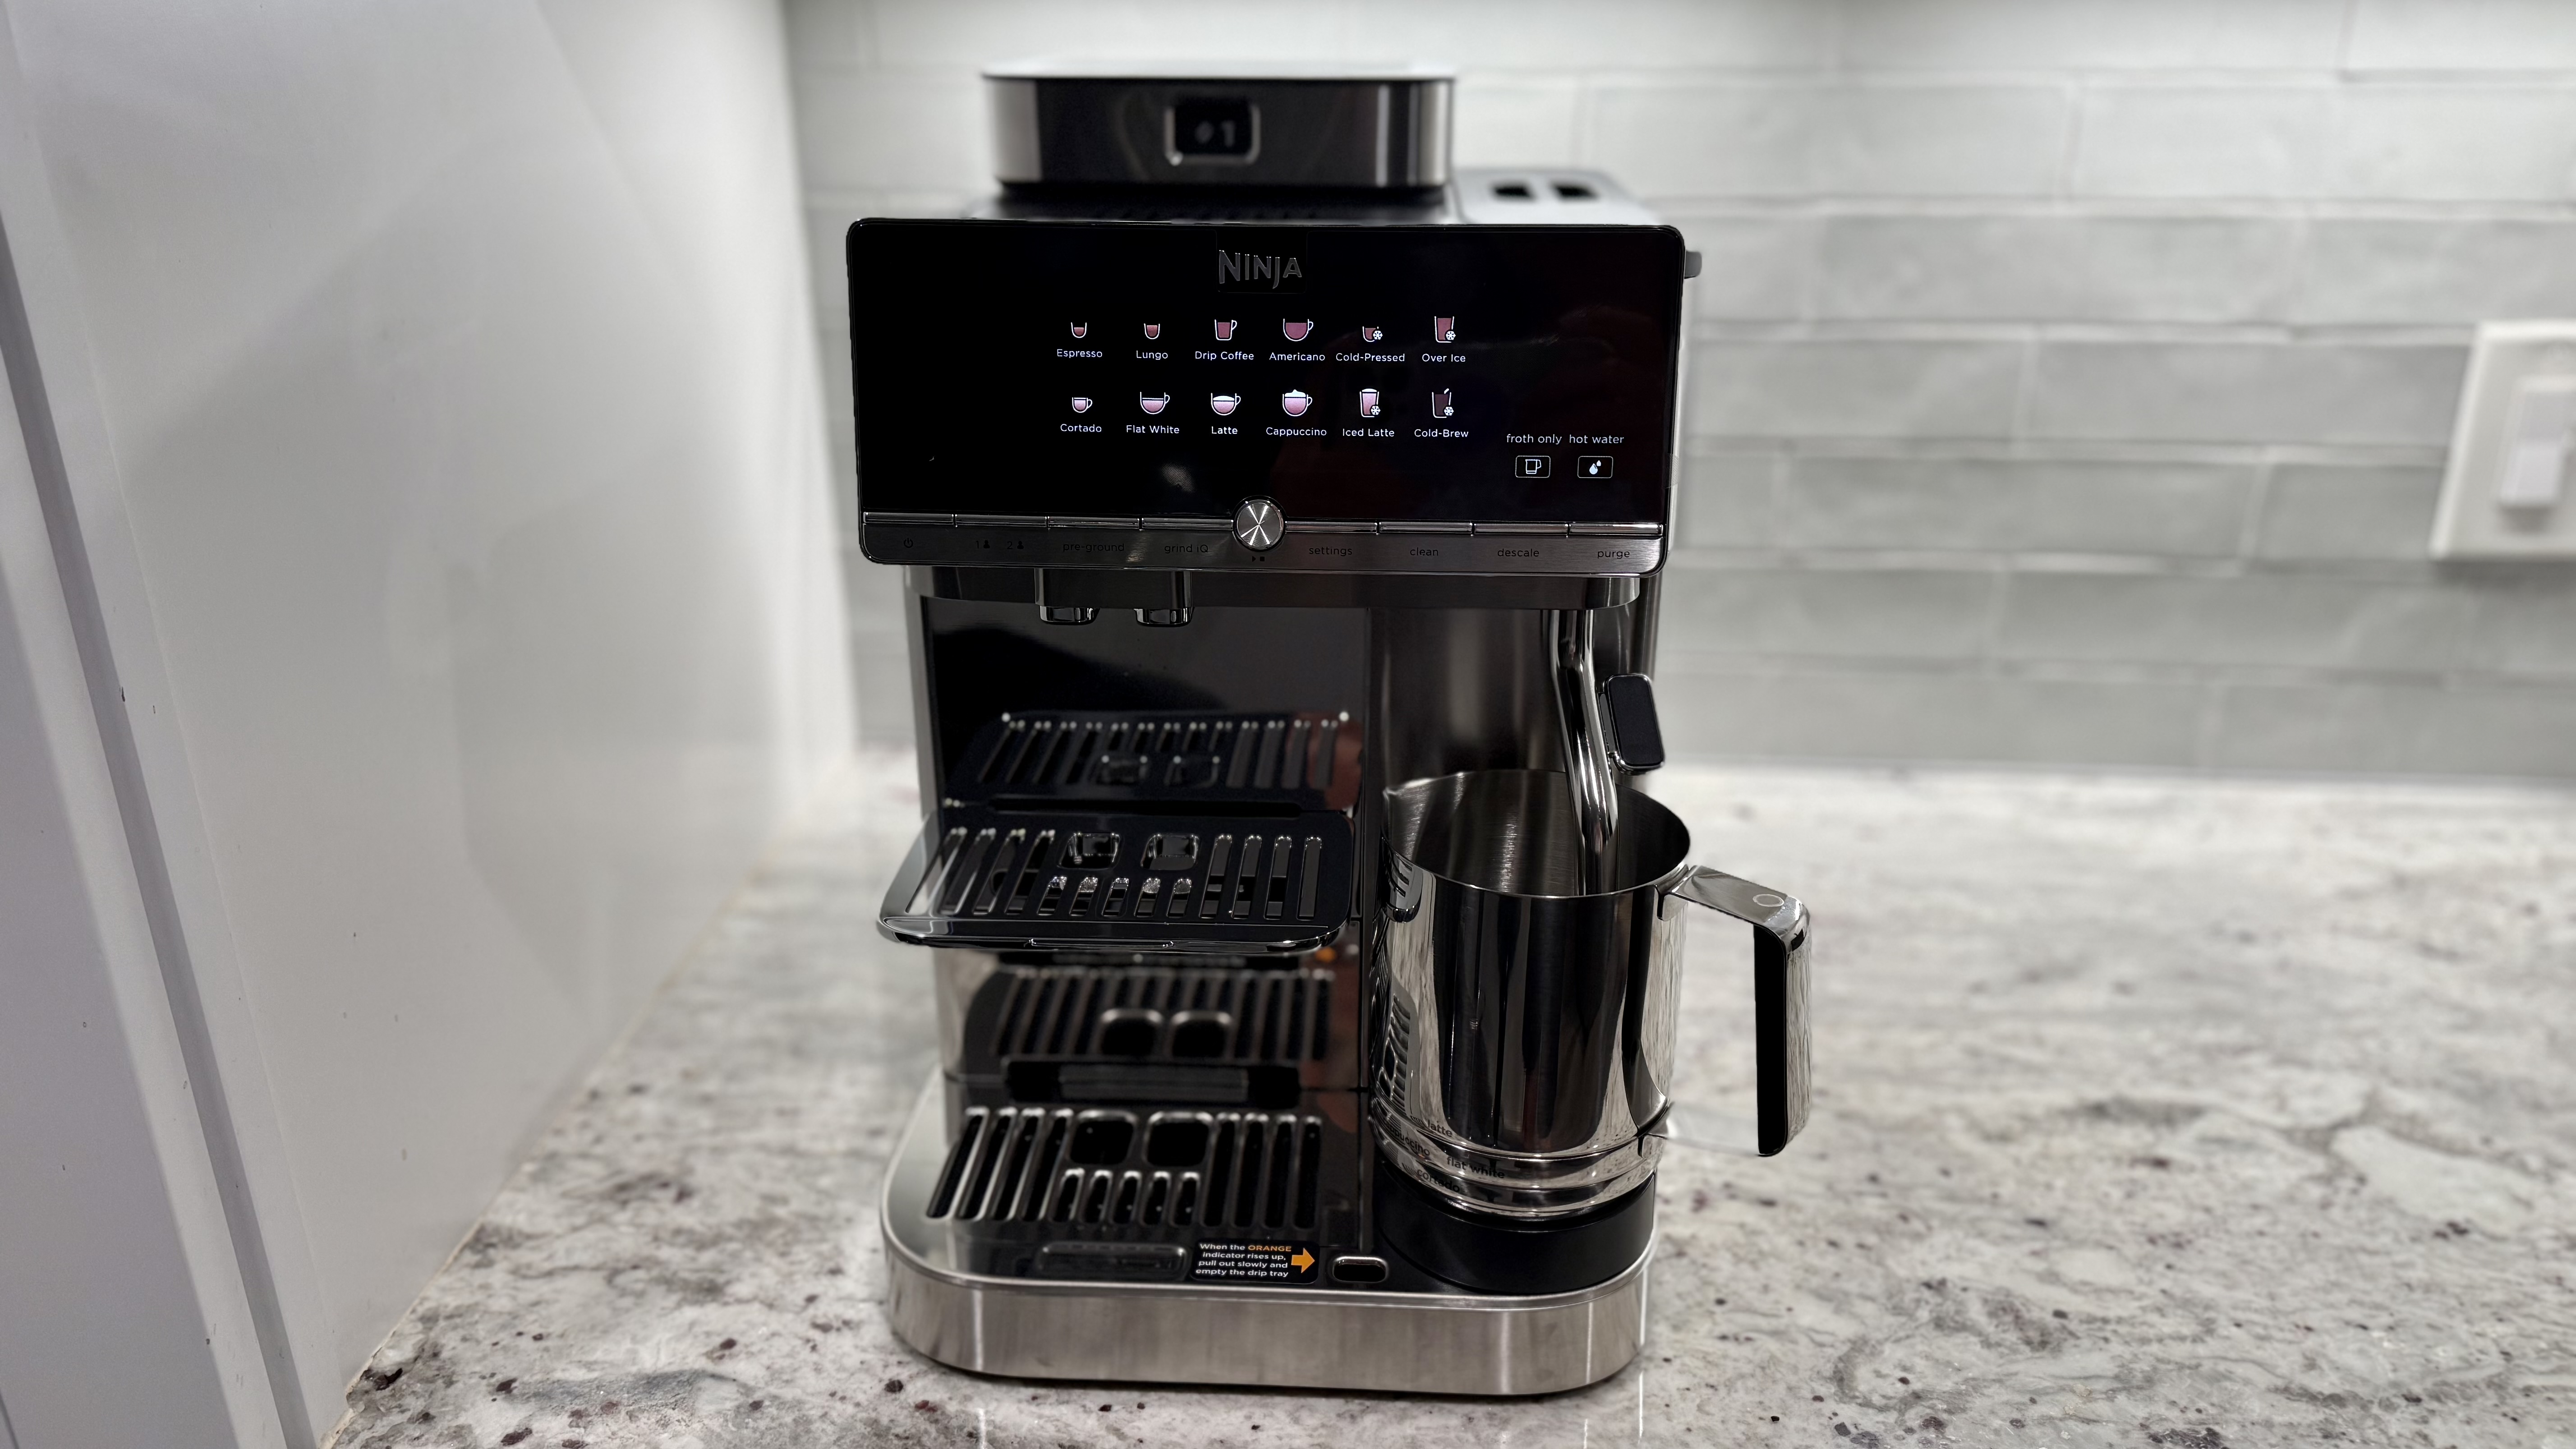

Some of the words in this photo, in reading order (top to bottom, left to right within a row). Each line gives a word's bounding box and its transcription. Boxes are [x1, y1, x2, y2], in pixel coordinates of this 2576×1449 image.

[1219, 250, 1302, 289] NINJA
[1057, 349, 1103, 359] Espresso
[1136, 350, 1168, 360] Lungo
[1195, 351, 1217, 361] Drip
[1220, 351, 1254, 360] Coffee
[1269, 352, 1325, 361] Americano
[1336, 353, 1405, 362] Cold-Pressed
[1422, 353, 1447, 362] Over
[1451, 354, 1466, 362] Ice
[1060, 423, 1102, 432] Cortado
[1126, 425, 1145, 433] Flat
[1151, 425, 1180, 434] White
[1211, 426, 1238, 434] Latte
[1266, 427, 1327, 437] Cappuccino
[1343, 428, 1364, 437] Iced
[1368, 428, 1394, 437] Latte
[1414, 428, 1469, 437] Cold-Brew
[1506, 433, 1534, 443] froth
[1538, 434, 1562, 445] only
[1569, 434, 1588, 444] hot
[1592, 435, 1624, 444] water
[1063, 543, 1125, 553] pre-ground
[1164, 543, 1192, 554] grind
[1197, 544, 1209, 553] iQ
[1309, 546, 1352, 557] settings
[1410, 547, 1439, 557] clean
[1497, 547, 1539, 557] descale
[1597, 550, 1630, 560] purge
[1427, 1120, 1453, 1137] latte
[1447, 1156, 1466, 1170] flat
[1470, 1165, 1505, 1178] white
[1417, 1169, 1460, 1192] cortado
